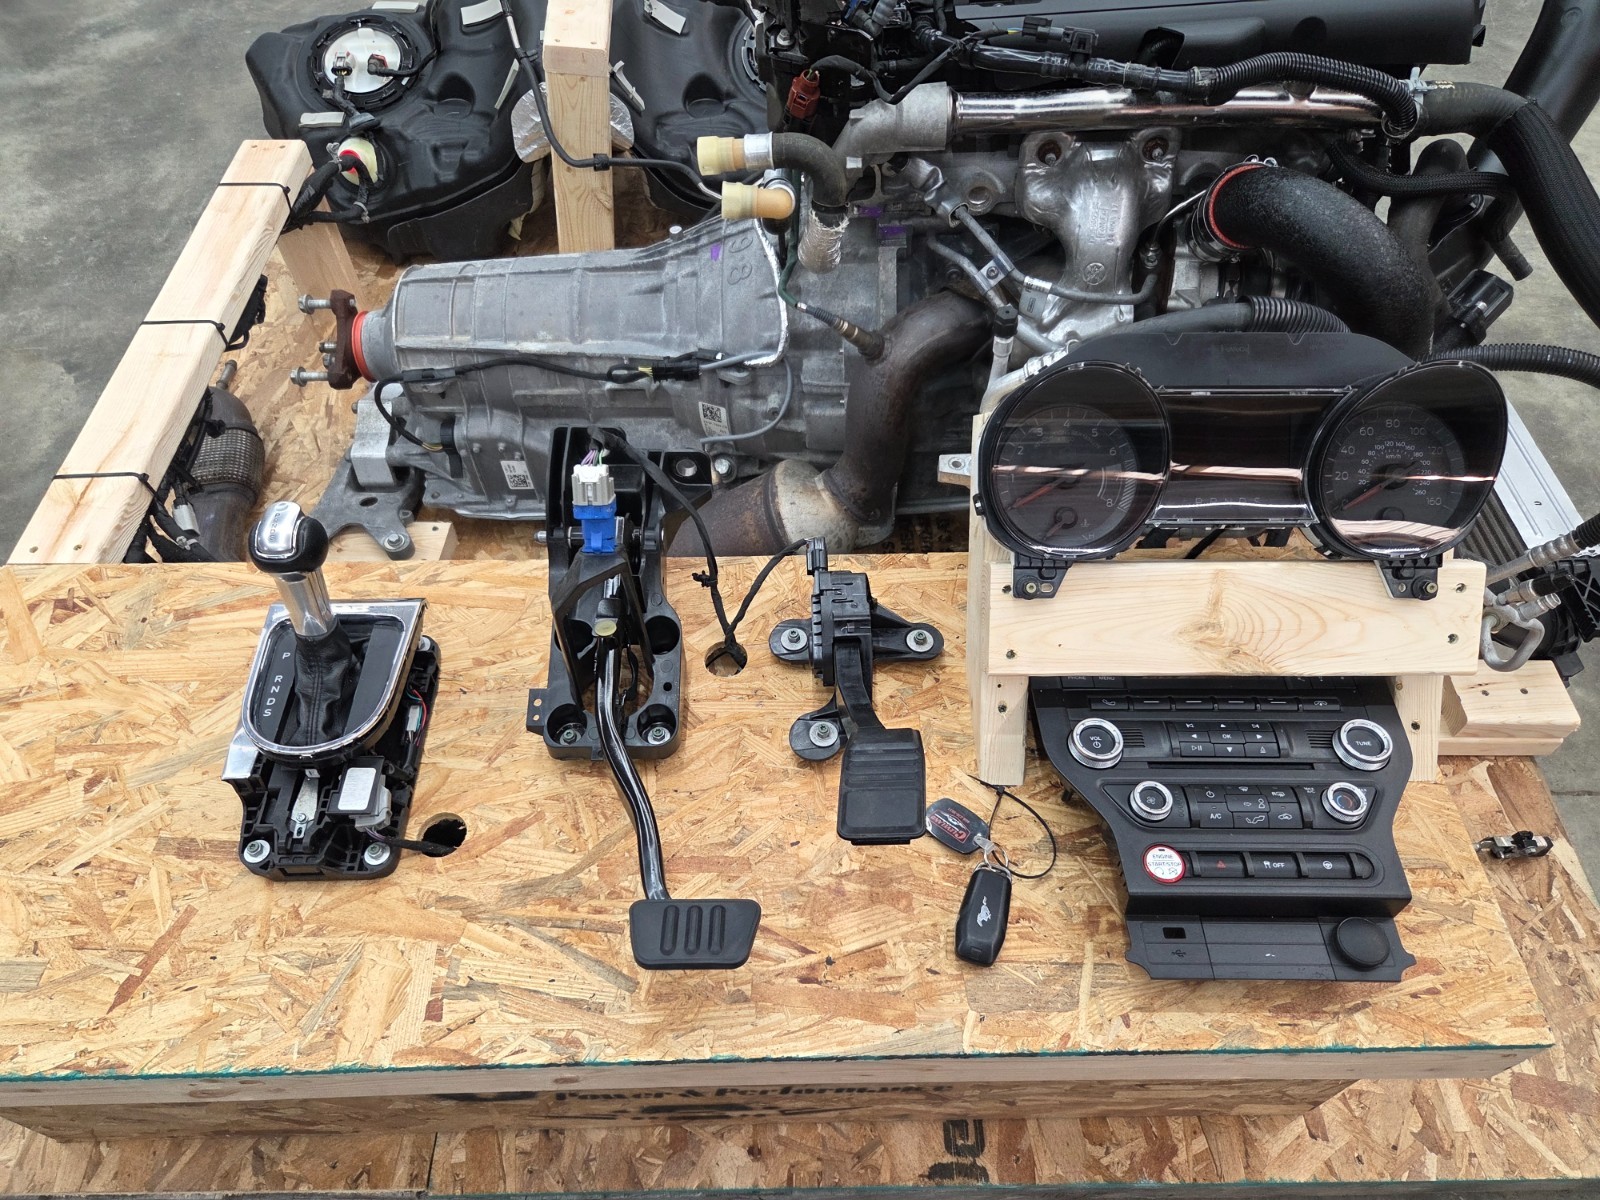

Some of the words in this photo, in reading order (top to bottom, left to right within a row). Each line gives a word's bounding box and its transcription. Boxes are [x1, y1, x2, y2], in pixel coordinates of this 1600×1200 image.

[1385, 419, 1401, 428] 80
[1091, 428, 1099, 437] 5
[1359, 427, 1375, 436] 60
[1410, 427, 1425, 436] 100
[1017, 446, 1024, 456] 2
[1109, 446, 1117, 456] 6
[1340, 446, 1356, 455] 40
[1334, 472, 1349, 481] 20
[1106, 498, 1113, 508] 8
[1426, 497, 1442, 506] 160
[282, 652, 291, 660] P
[274, 675, 283, 683] R
[270, 685, 280, 694] N
[266, 697, 276, 706] D
[262, 708, 272, 717] S
[1210, 812, 1222, 820] A/C
